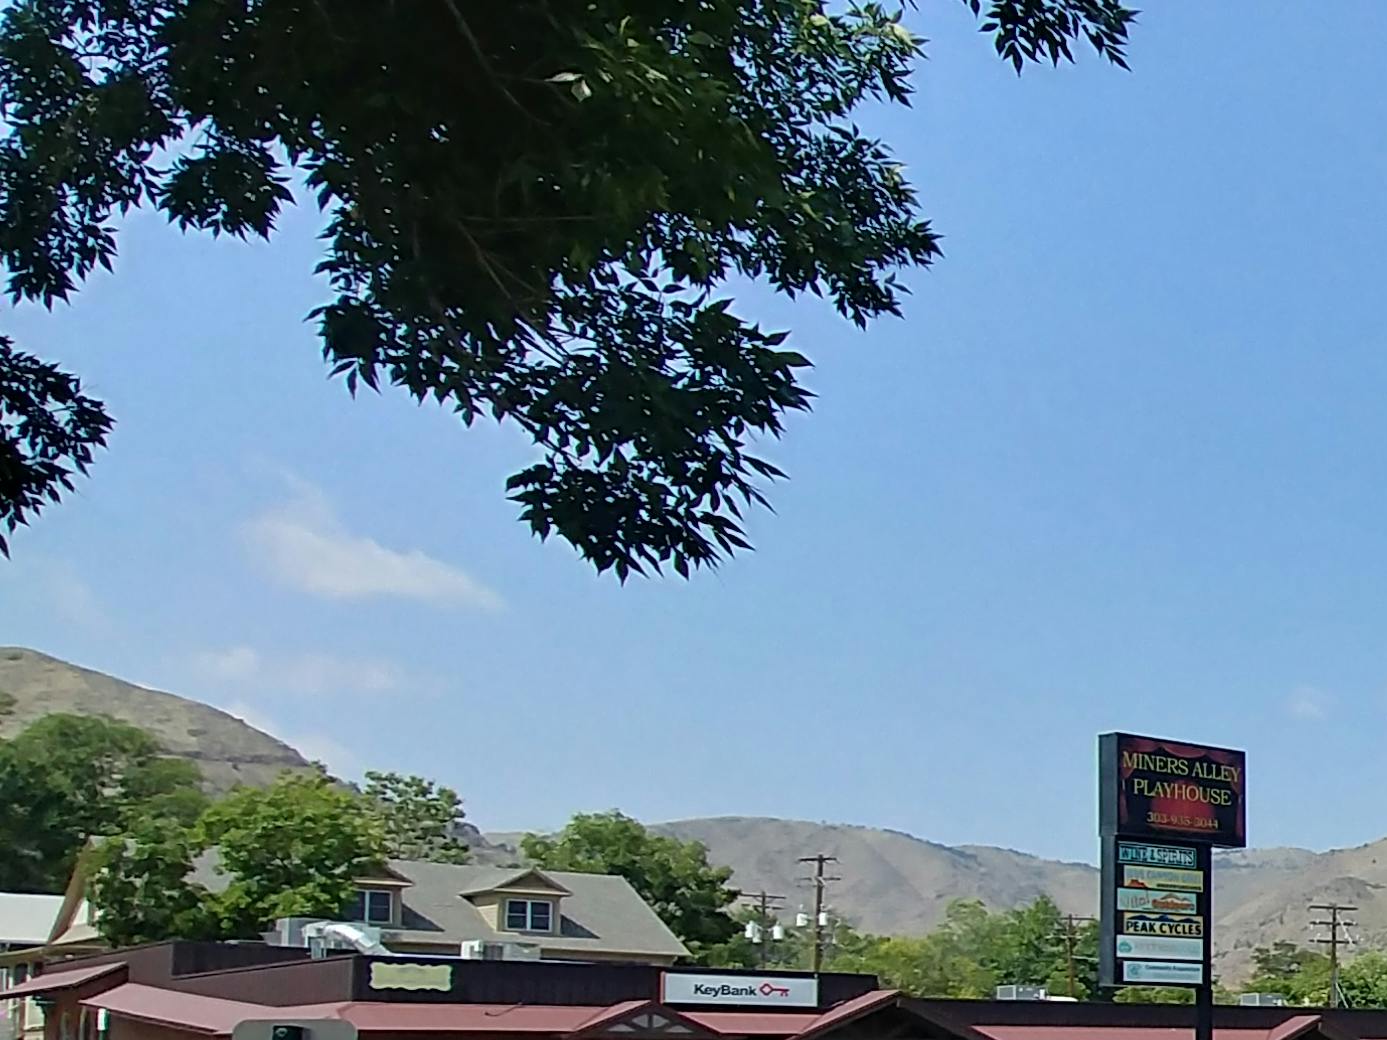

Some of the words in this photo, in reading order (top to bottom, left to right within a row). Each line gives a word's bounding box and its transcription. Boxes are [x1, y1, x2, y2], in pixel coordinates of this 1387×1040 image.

[1122, 751, 1189, 776] MINERS
[1192, 760, 1242, 783] ALLEY
[1133, 778, 1232, 806] PLAYHOUSE
[1126, 920, 1157, 933] PEAK
[1159, 922, 1202, 936] CYCLES
[694, 984, 757, 996] KeyBank
